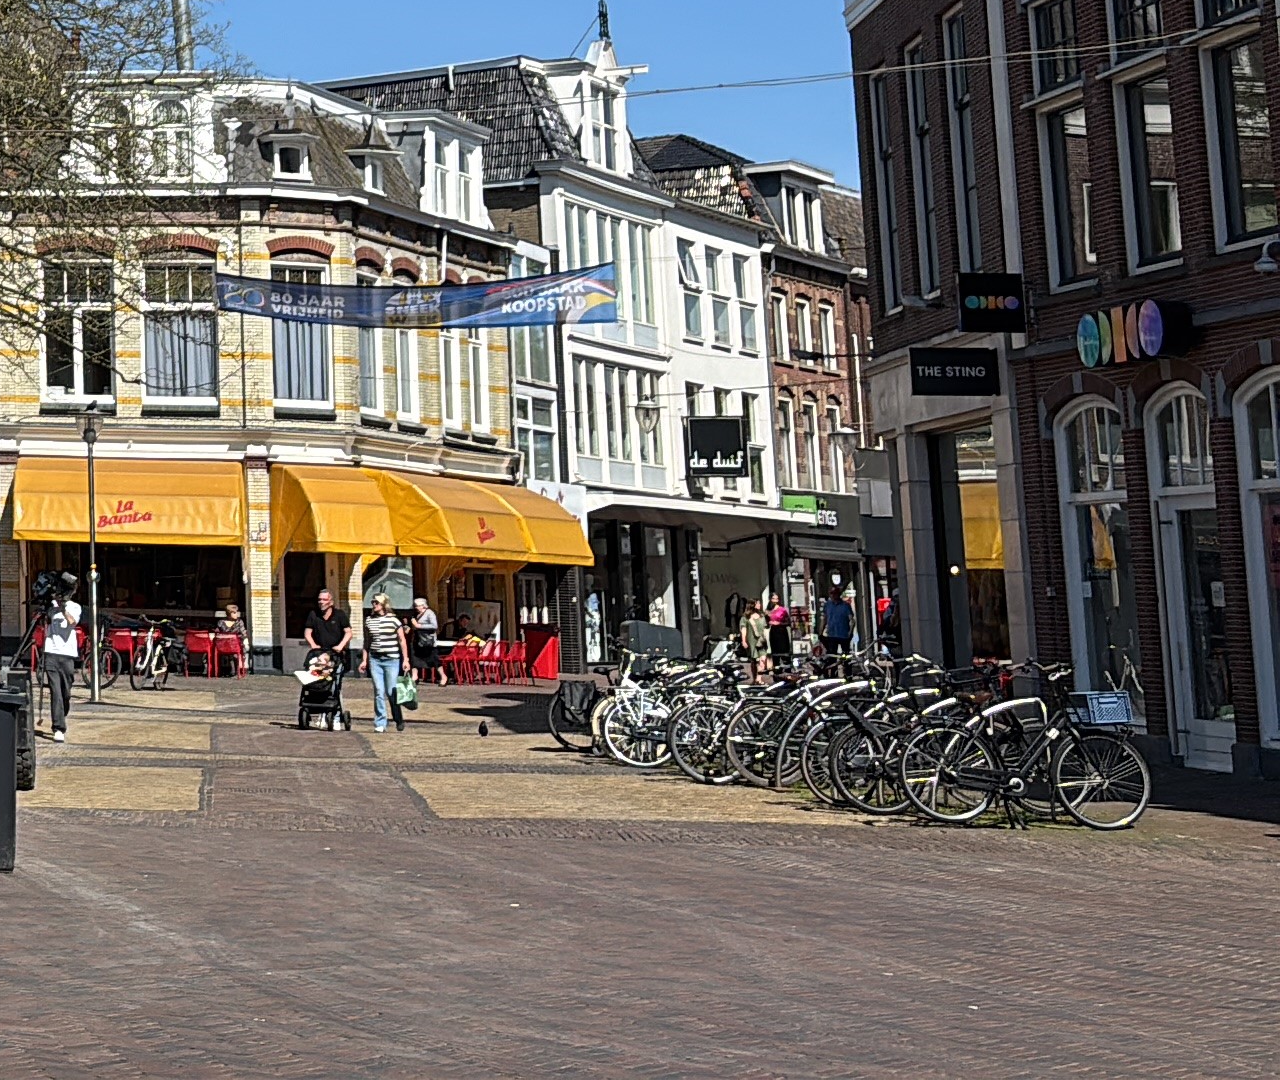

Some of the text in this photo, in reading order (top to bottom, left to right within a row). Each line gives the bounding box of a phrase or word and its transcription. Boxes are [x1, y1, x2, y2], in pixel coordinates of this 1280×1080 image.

[270, 291, 345, 308] 80 JAAR
[501, 295, 587, 314] KOOPSTAD
[270, 304, 344, 319] VRIJHEID
[916, 365, 986, 378] THE STING
[690, 450, 744, 468] de duif
[116, 500, 134, 513] La
[97, 511, 152, 528] Bamba
